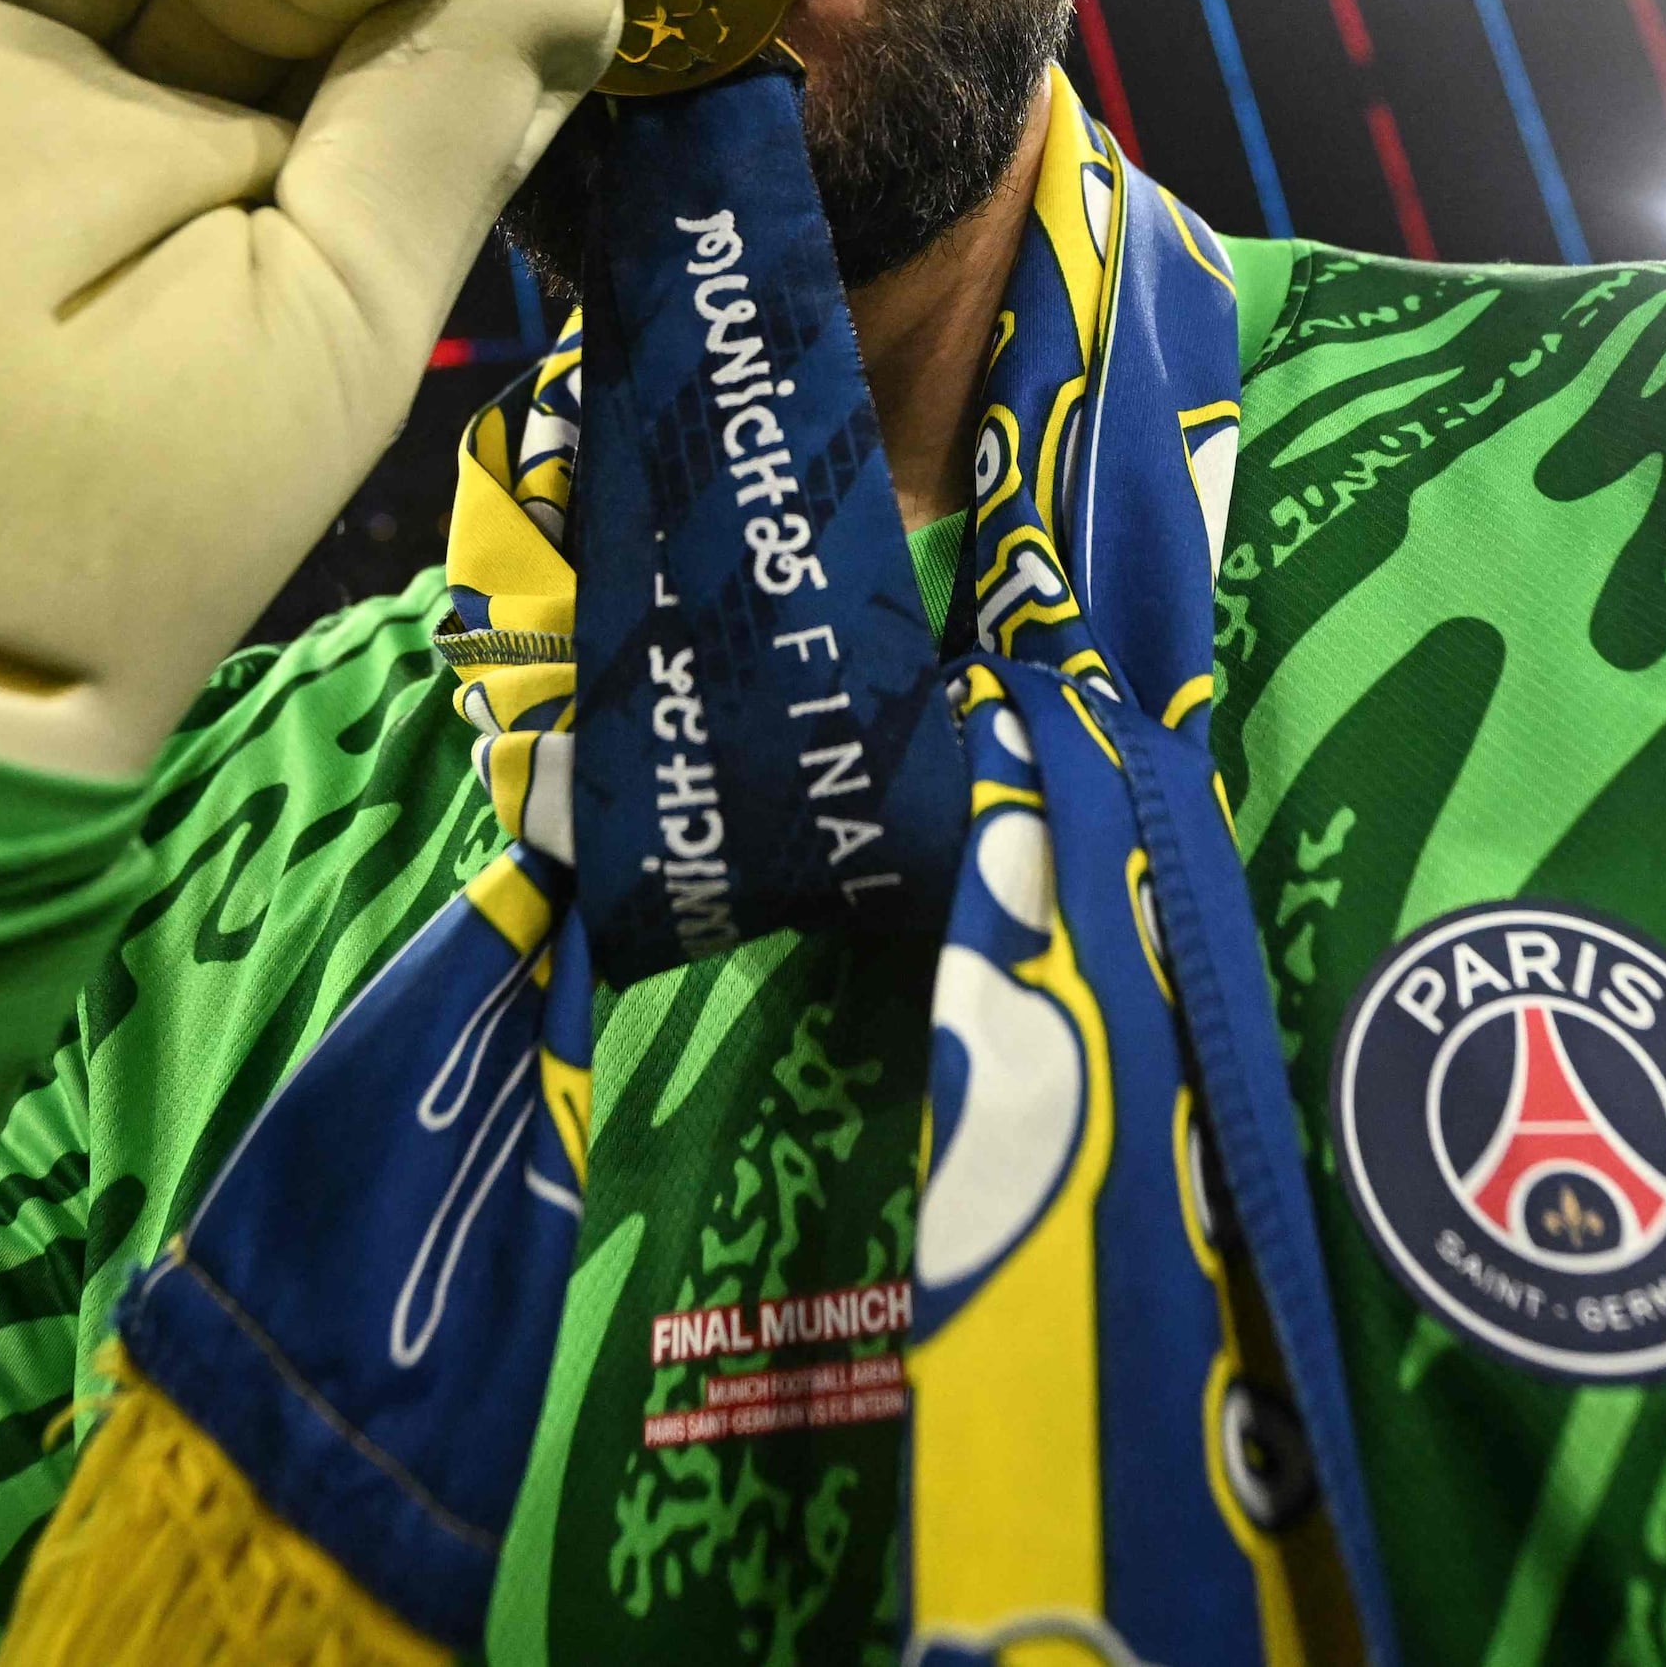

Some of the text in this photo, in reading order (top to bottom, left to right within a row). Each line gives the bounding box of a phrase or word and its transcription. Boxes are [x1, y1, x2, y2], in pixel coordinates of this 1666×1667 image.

[773, 625, 901, 906] FINAL
[1394, 930, 1665, 1035] PARIS
[1435, 1229, 1548, 1320] SAINT
[652, 1285, 913, 1364] FINAL MUNICH
